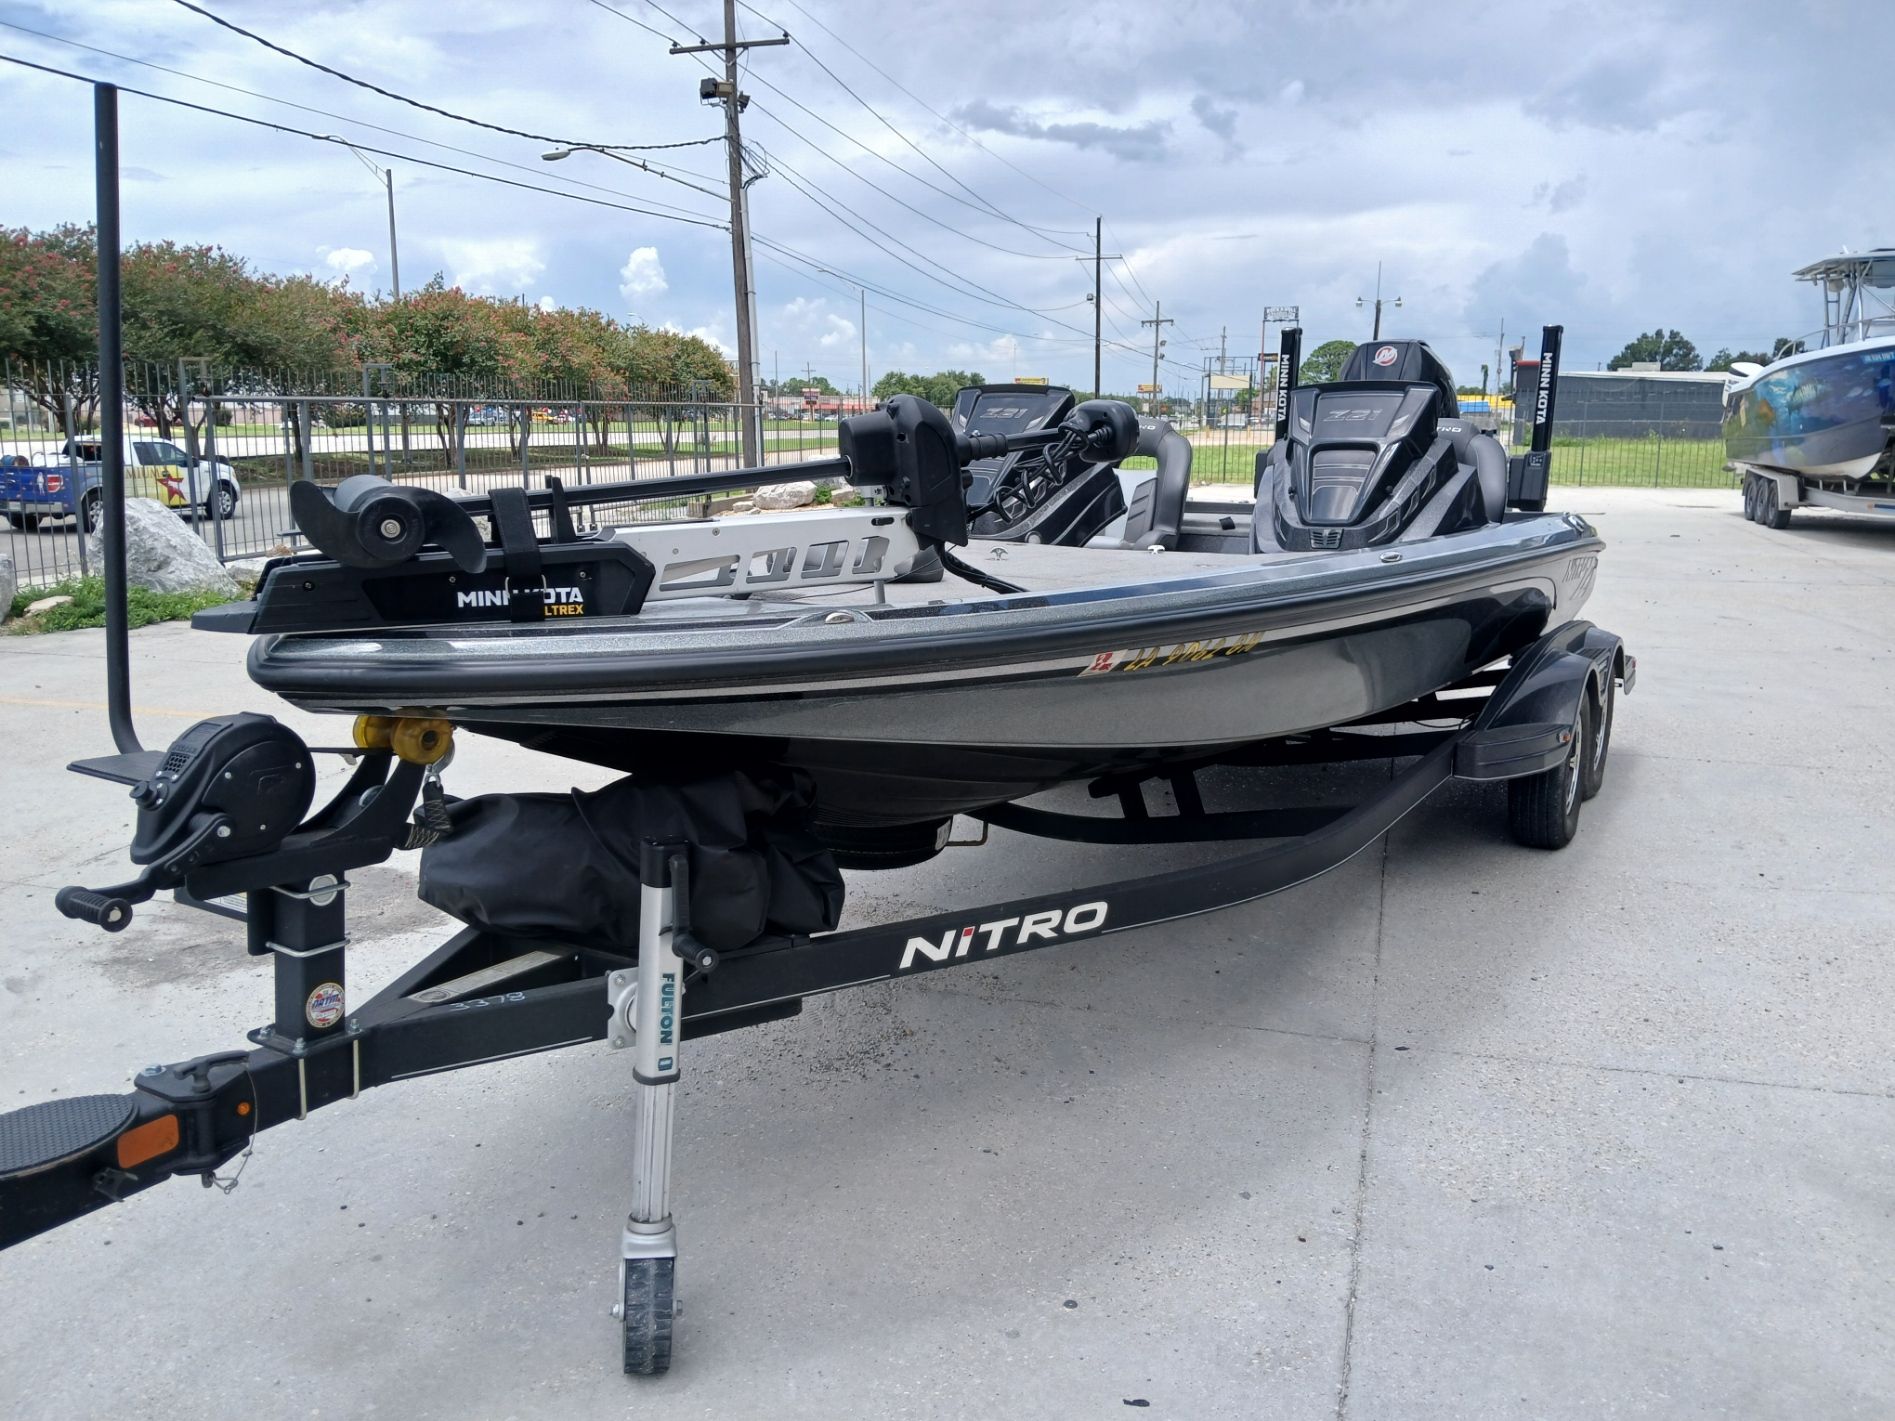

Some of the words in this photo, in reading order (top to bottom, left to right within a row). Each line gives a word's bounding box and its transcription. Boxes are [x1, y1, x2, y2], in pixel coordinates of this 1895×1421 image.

[1280, 354, 1290, 388] MINN
[1540, 352, 1553, 388] MINN
[1277, 389, 1288, 422] KOTA
[1536, 390, 1550, 425] KOTA
[544, 604, 584, 616] LTREX
[898, 901, 1109, 970] NITRO
[660, 973, 676, 1044] FULTON
